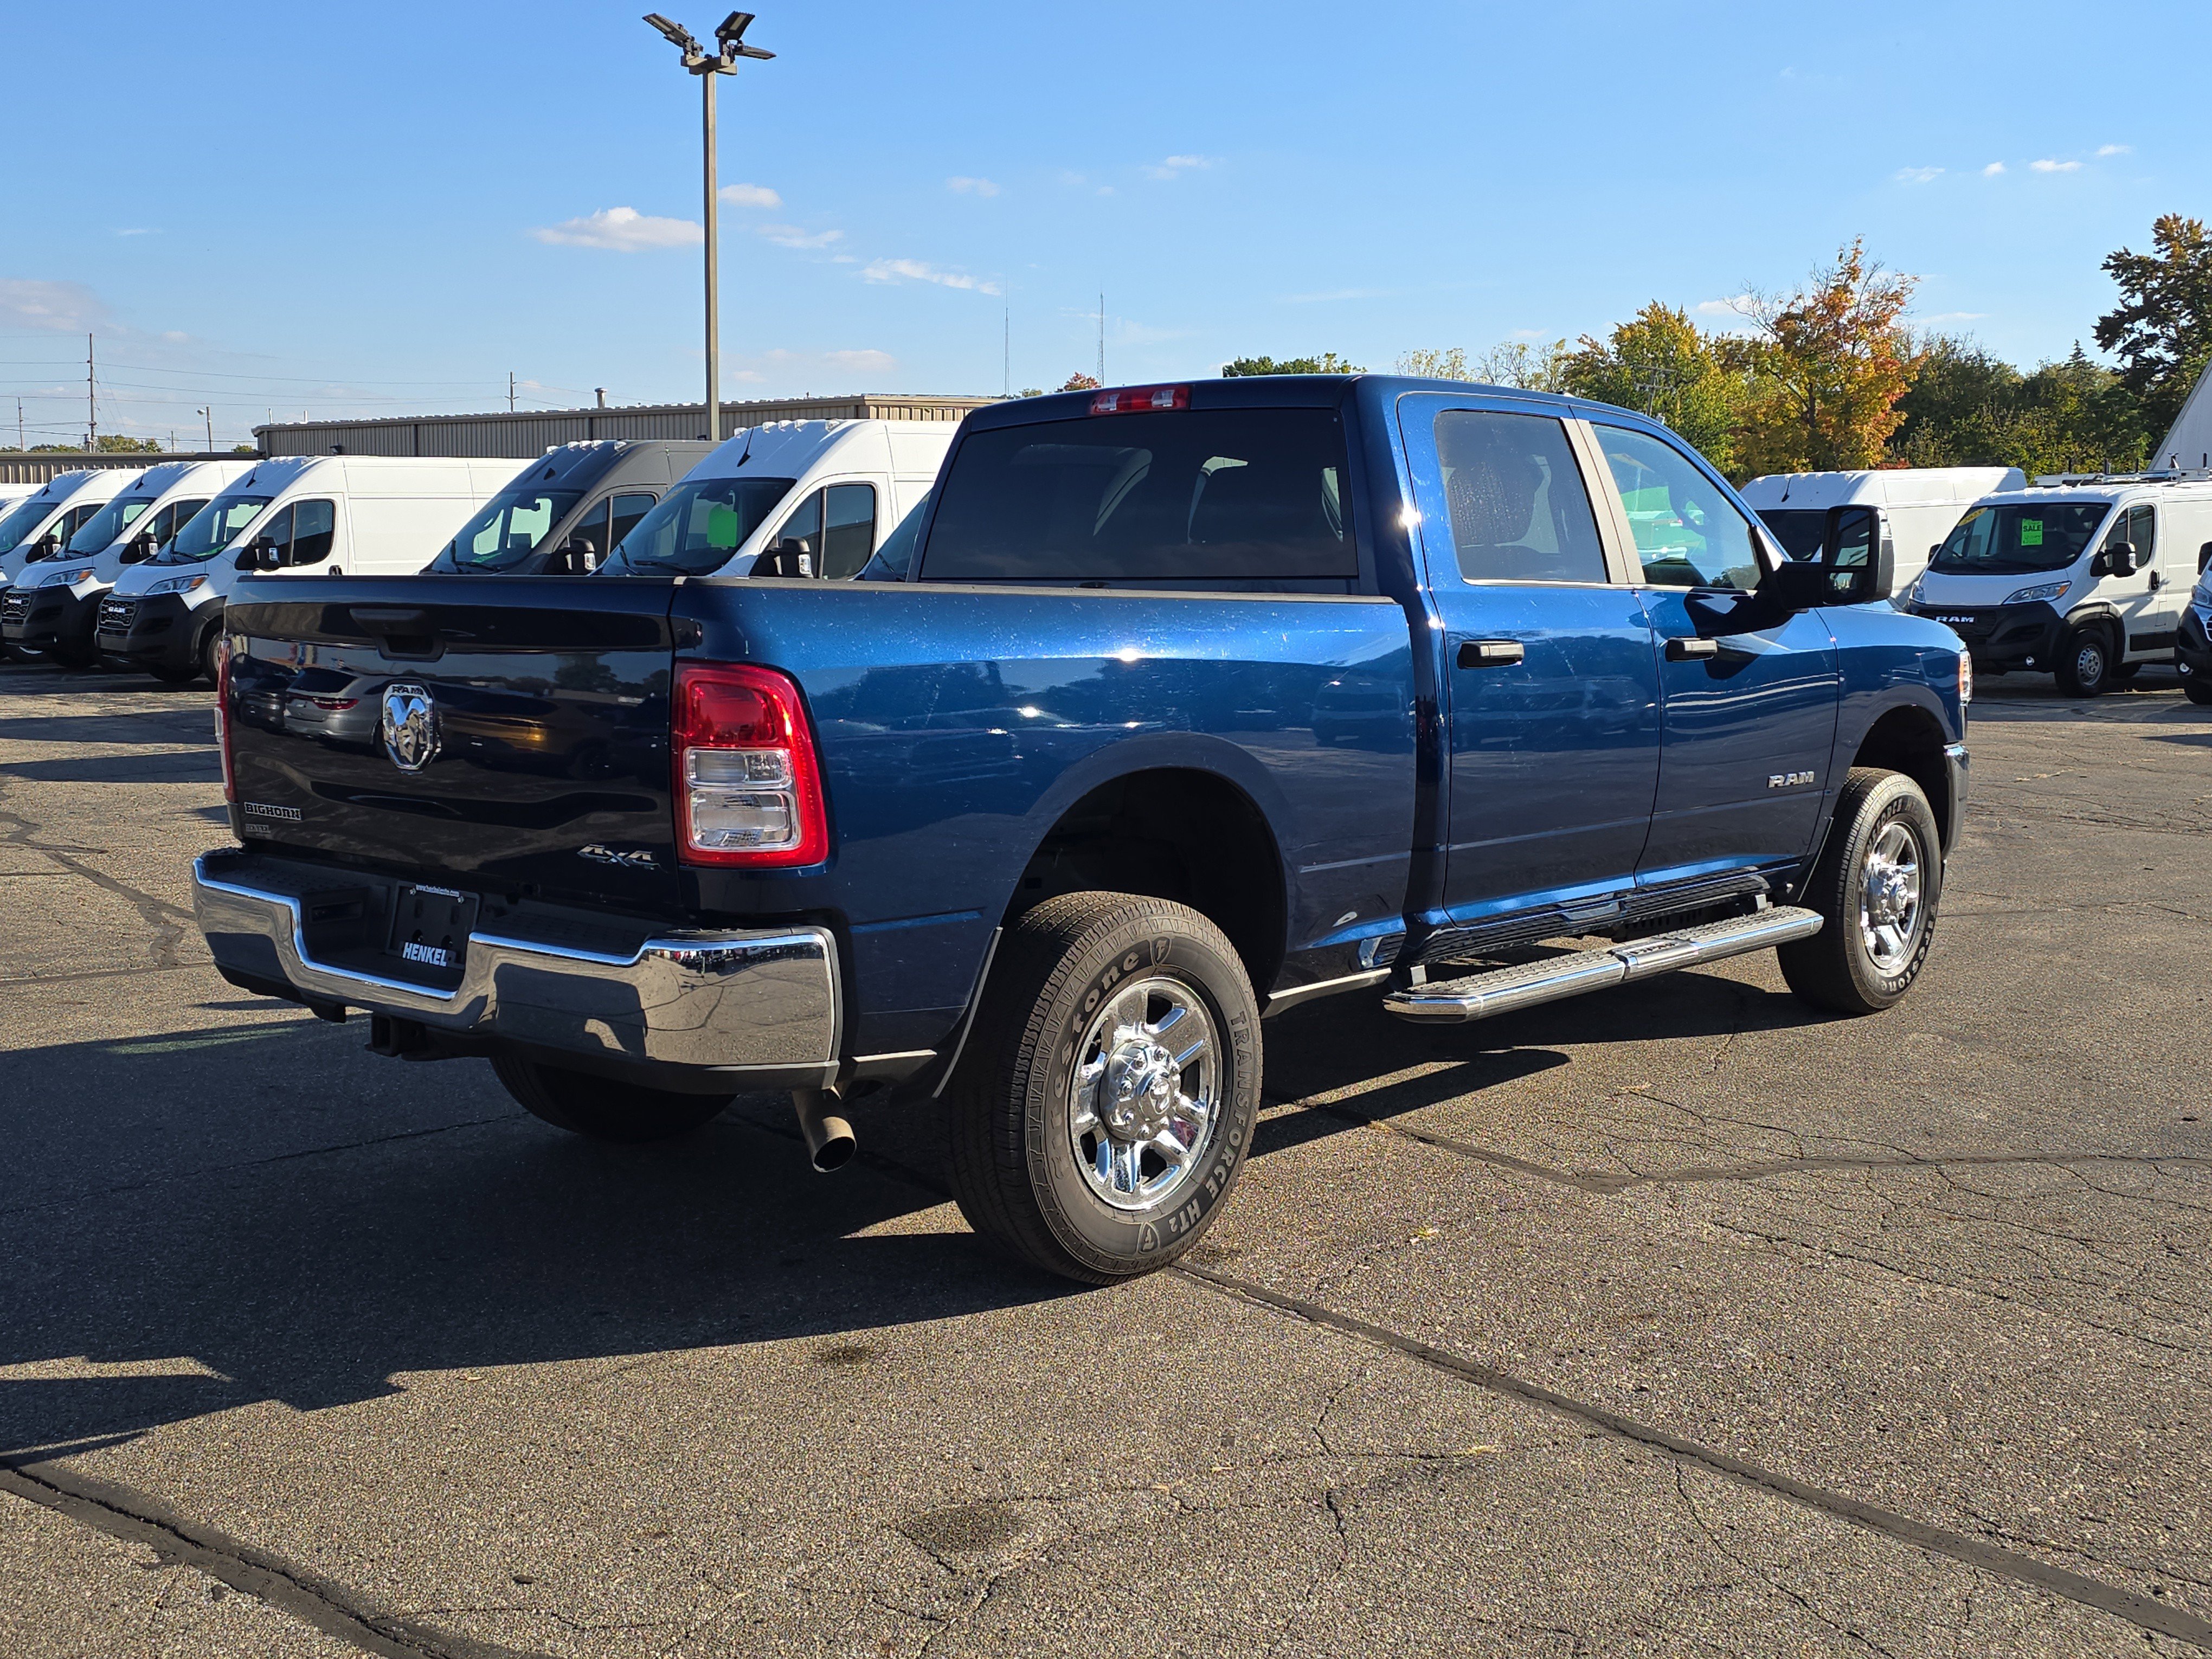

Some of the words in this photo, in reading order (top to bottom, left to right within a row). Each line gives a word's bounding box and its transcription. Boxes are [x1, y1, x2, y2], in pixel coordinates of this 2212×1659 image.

[392, 685, 424, 695] RAM
[1767, 770, 1815, 788] RAM
[245, 802, 301, 820] BIGHORN
[402, 942, 447, 967] HENKEL
[1204, 1011, 1253, 1200] TRANSFORCE
[1168, 1197, 1202, 1236] HT2
